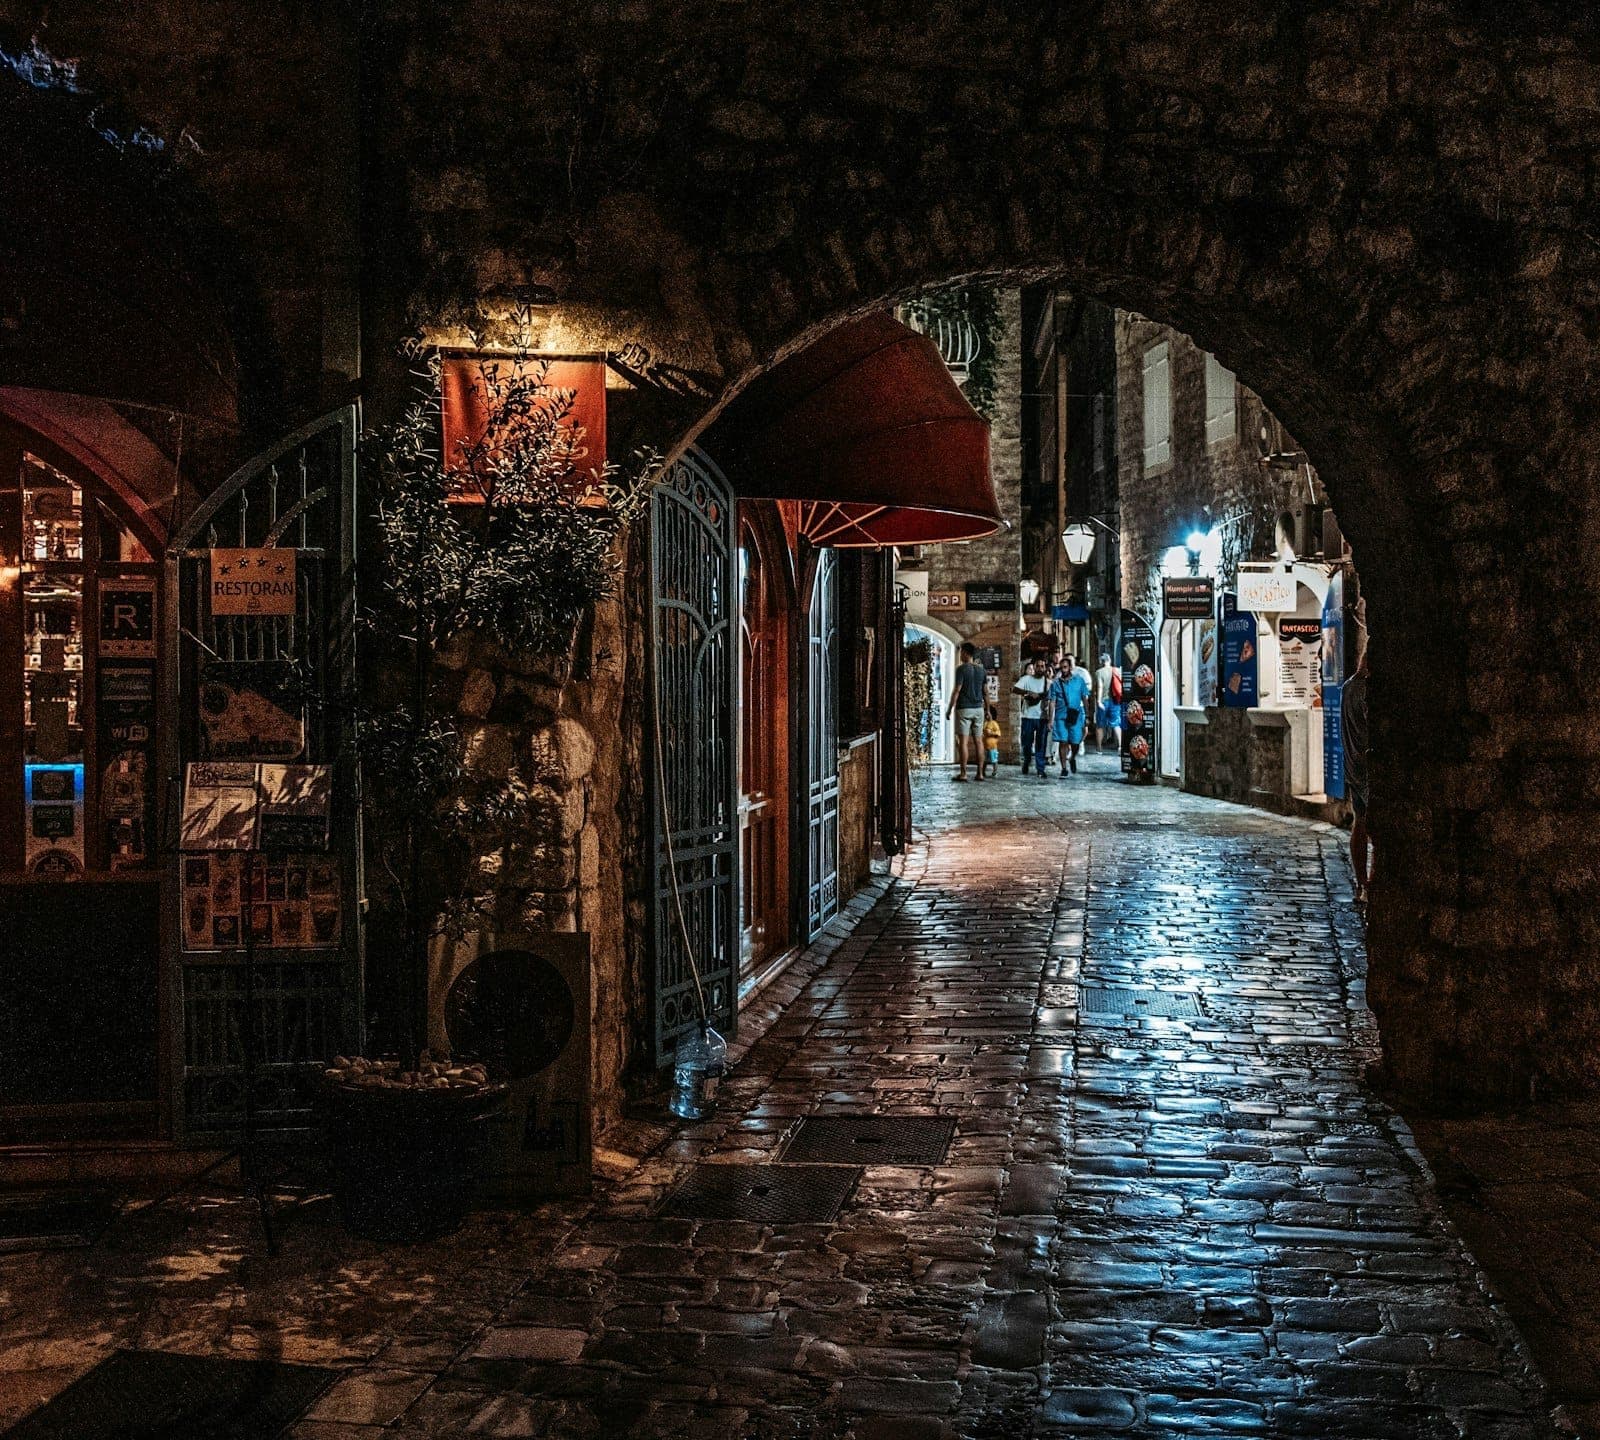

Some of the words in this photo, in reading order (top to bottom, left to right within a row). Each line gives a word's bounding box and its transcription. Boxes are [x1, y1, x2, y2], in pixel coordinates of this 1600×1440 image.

[214, 581, 294, 596] RESTORAN
[930, 595, 959, 606] HOP
[113, 604, 138, 630] R
[1282, 624, 1319, 633] FANTASTICO
